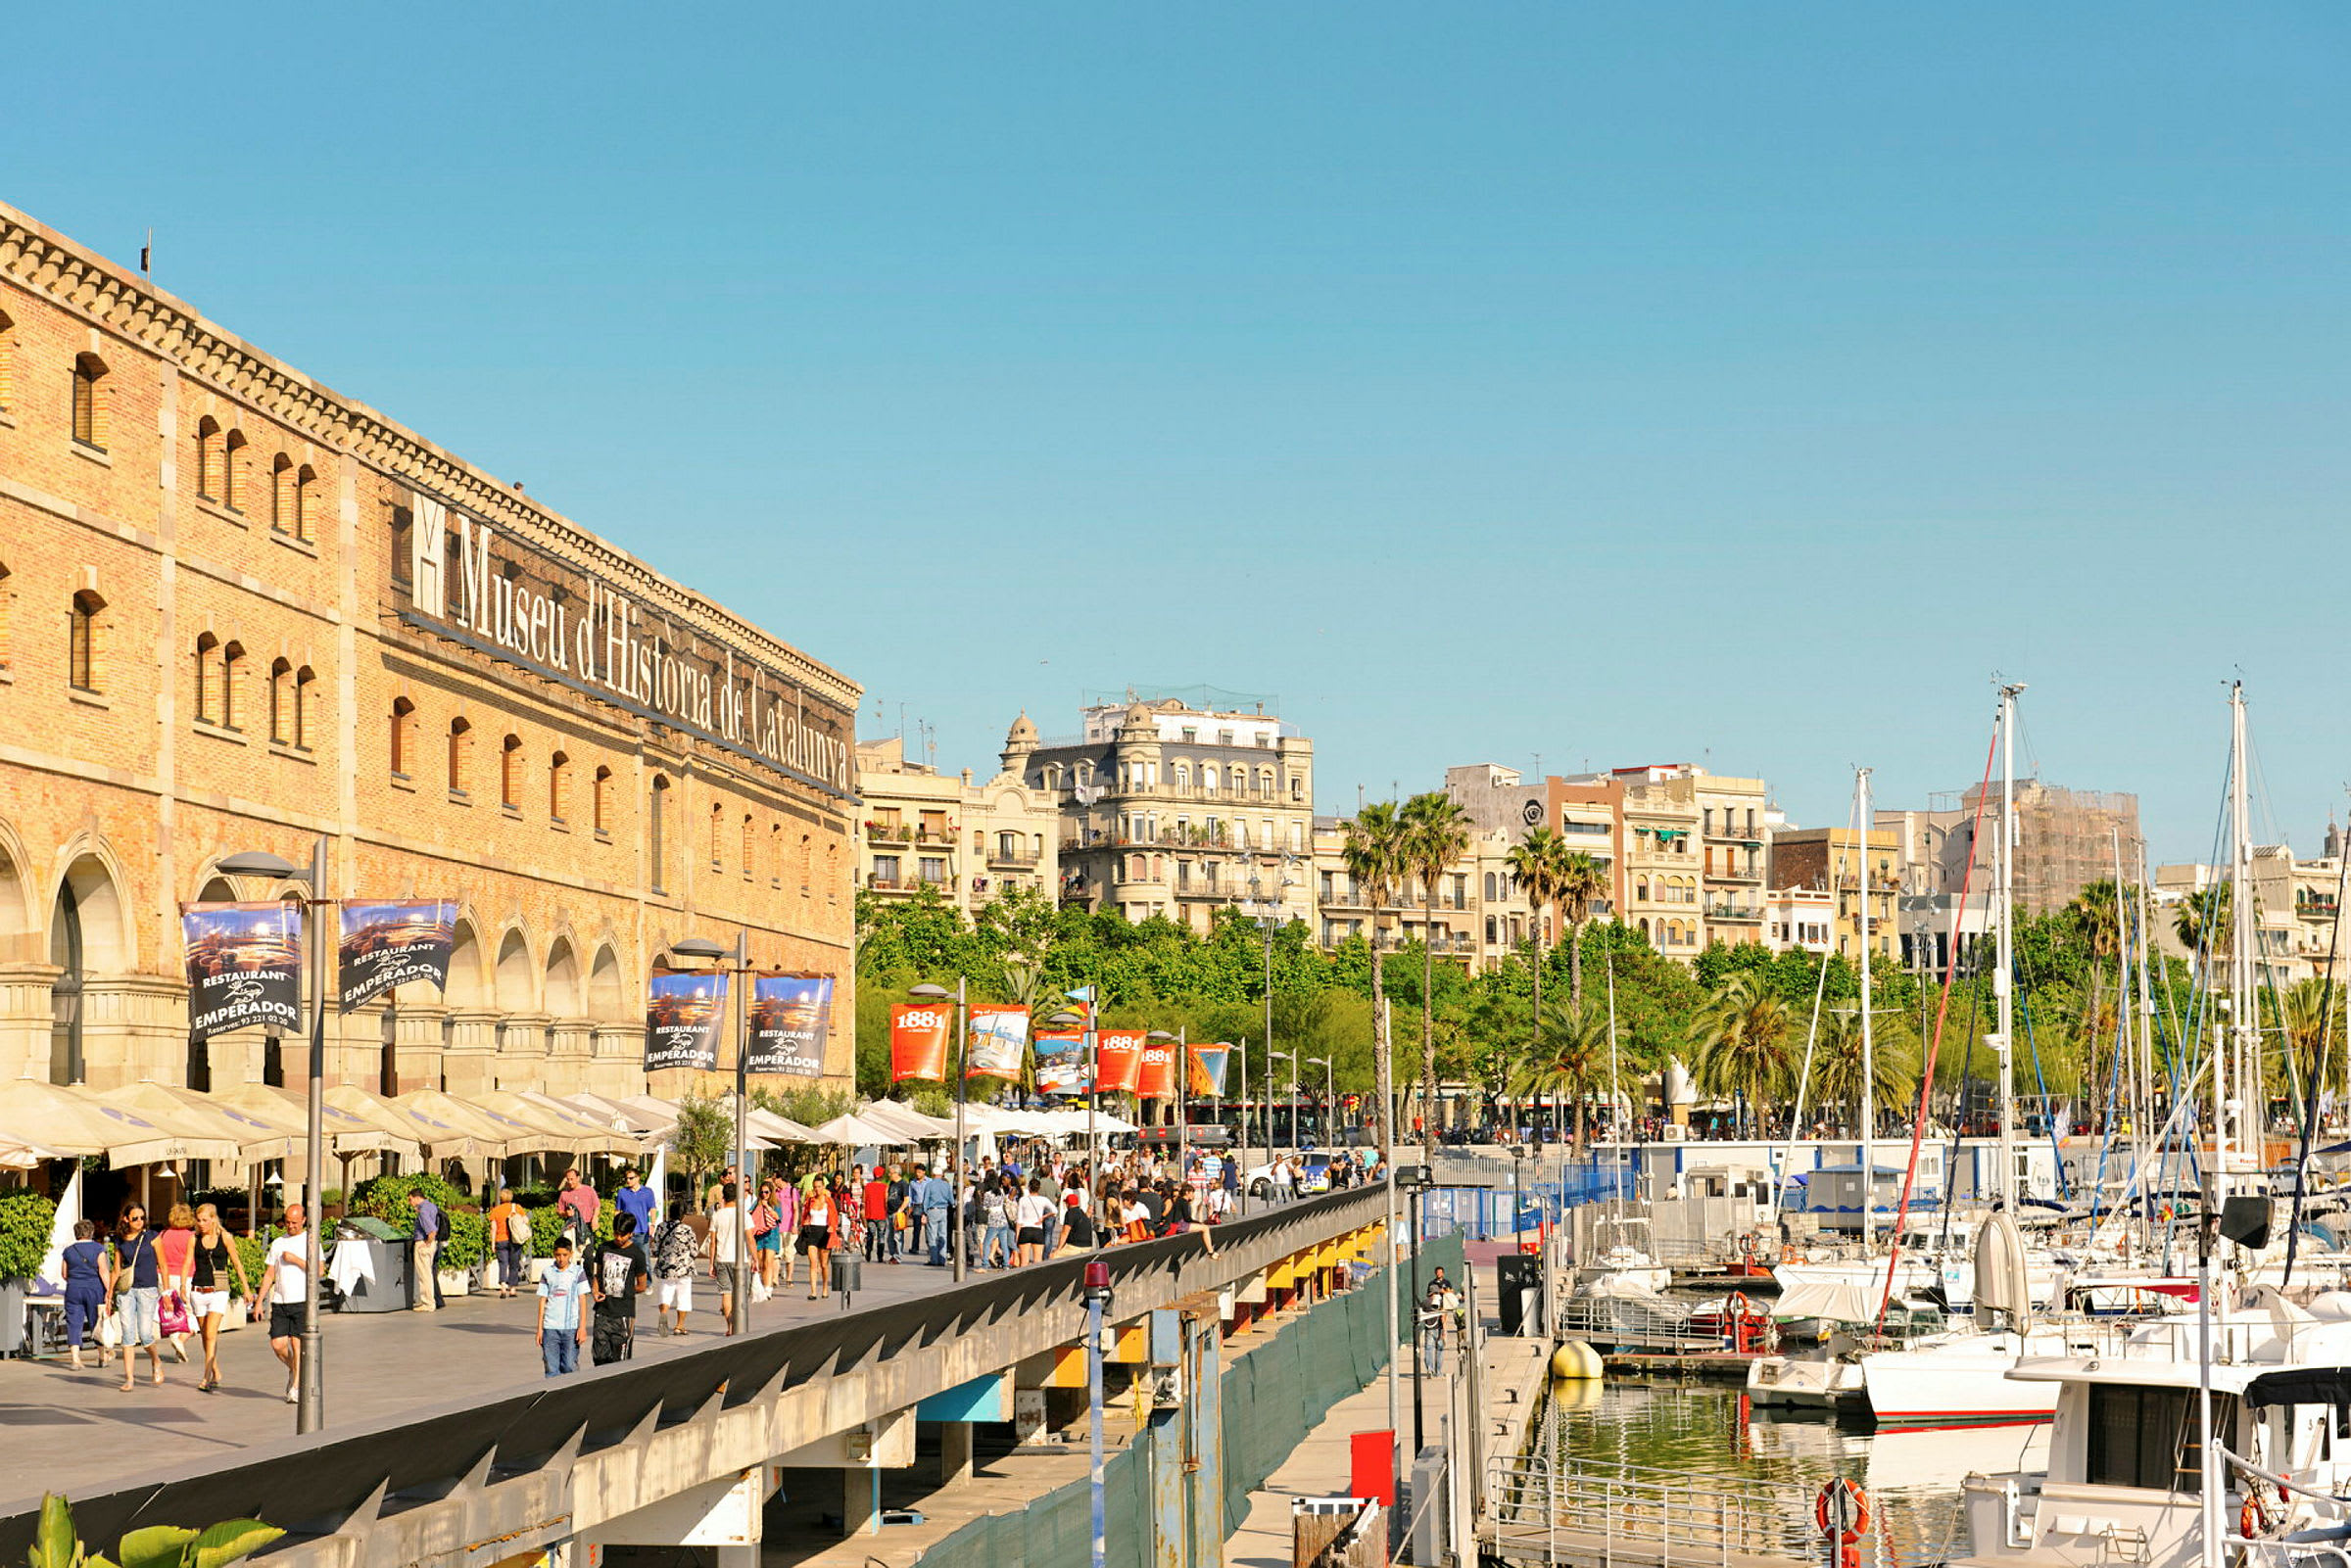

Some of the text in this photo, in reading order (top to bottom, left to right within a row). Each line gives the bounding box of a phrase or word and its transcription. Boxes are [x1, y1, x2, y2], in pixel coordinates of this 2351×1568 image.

[456, 512, 848, 791] Museu d'Història de Catalunya
[354, 943, 436, 967] RESTAURANT
[203, 971, 286, 989] RESTAURANT
[345, 963, 442, 1003] EMPERADOR
[195, 1000, 297, 1030] EMPERADOR
[240, 1017, 251, 1025] 93
[896, 1011, 945, 1028] 1881
[656, 1025, 710, 1034] RESTAURANT
[759, 1029, 815, 1041] RESTAURANT
[1102, 1035, 1140, 1051] 1881
[648, 1049, 714, 1063] EMPERADOR
[748, 1055, 820, 1069] EMPERADOR
[1141, 1050, 1172, 1064] 1881
[1396, 1221, 1410, 1244] A
